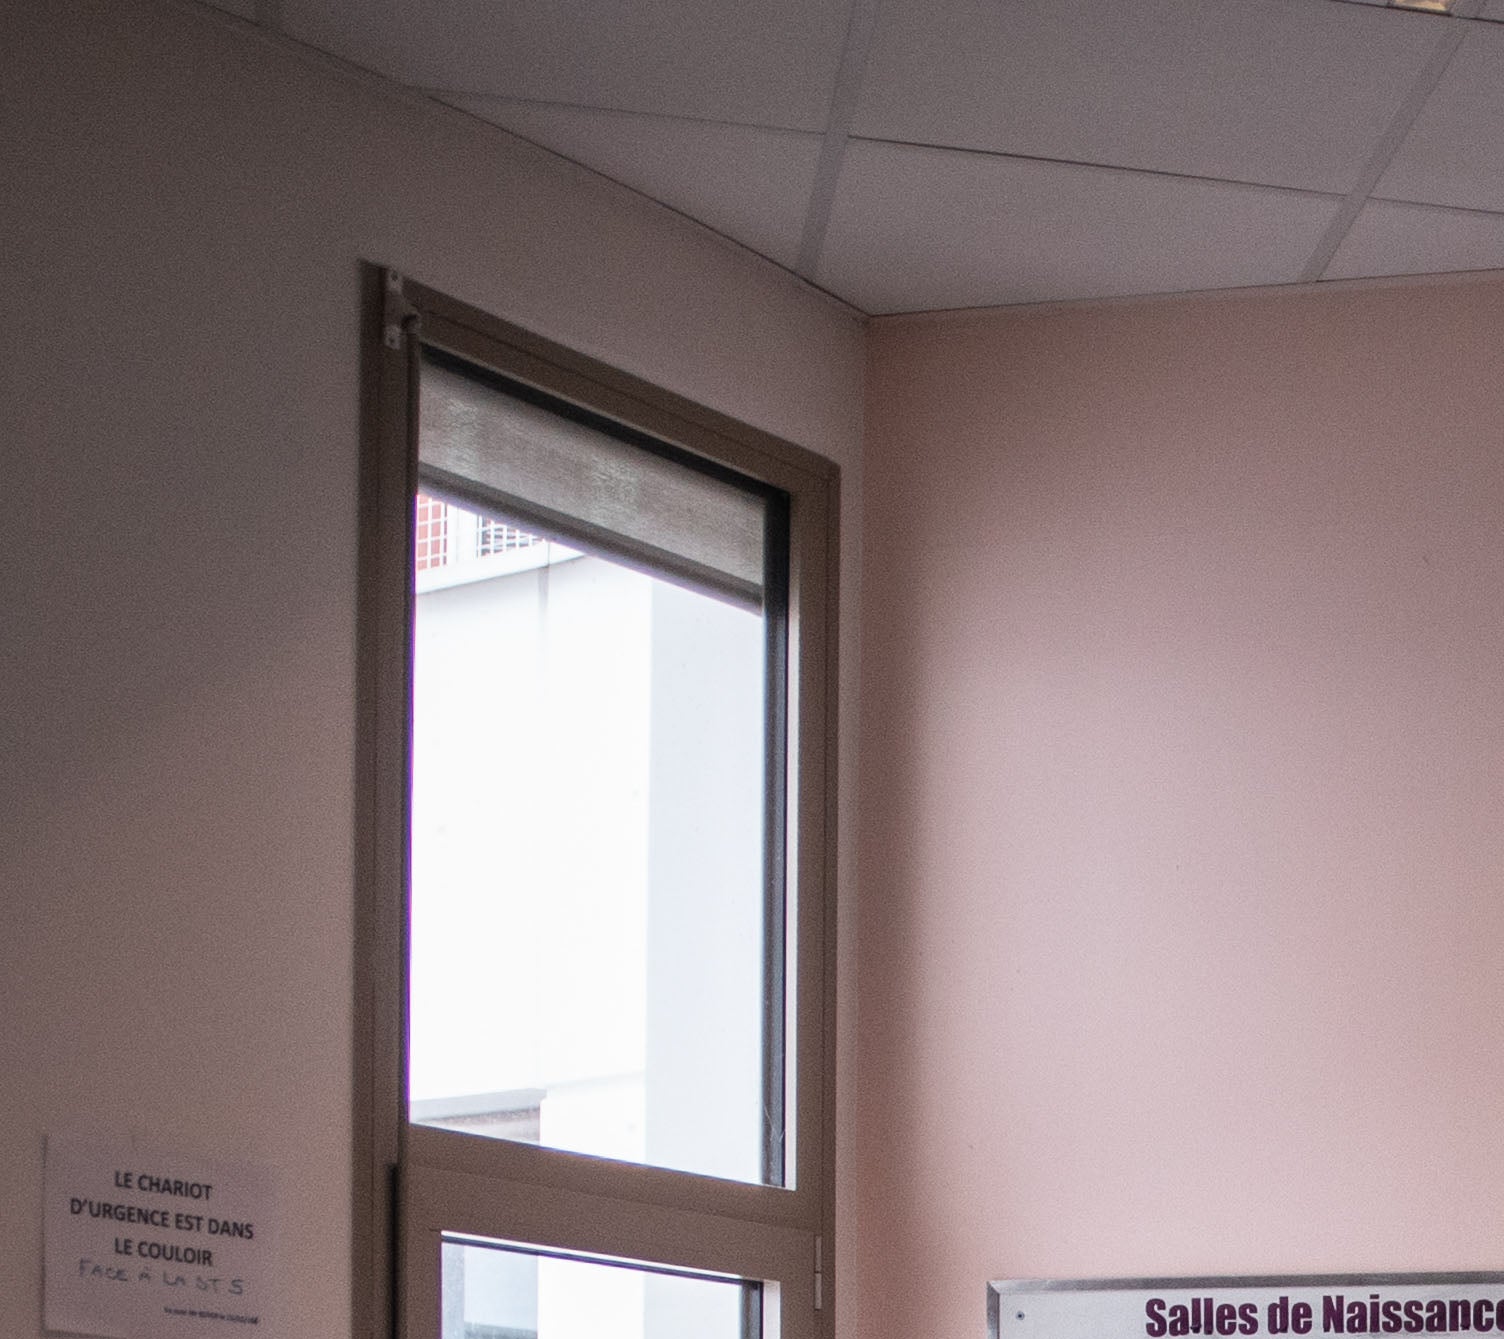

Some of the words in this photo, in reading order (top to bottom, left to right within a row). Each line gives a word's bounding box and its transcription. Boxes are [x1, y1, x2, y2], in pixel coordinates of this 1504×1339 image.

[114, 1171, 133, 1189] LE
[138, 1175, 213, 1201] CHARIOT
[69, 1197, 170, 1228] D'URGENCE
[174, 1212, 204, 1232] EST
[207, 1218, 255, 1240] DANS
[114, 1238, 133, 1255] LE
[137, 1241, 213, 1266] COULOIR
[1145, 1296, 1259, 1337] Salles
[1267, 1296, 1313, 1335] de
